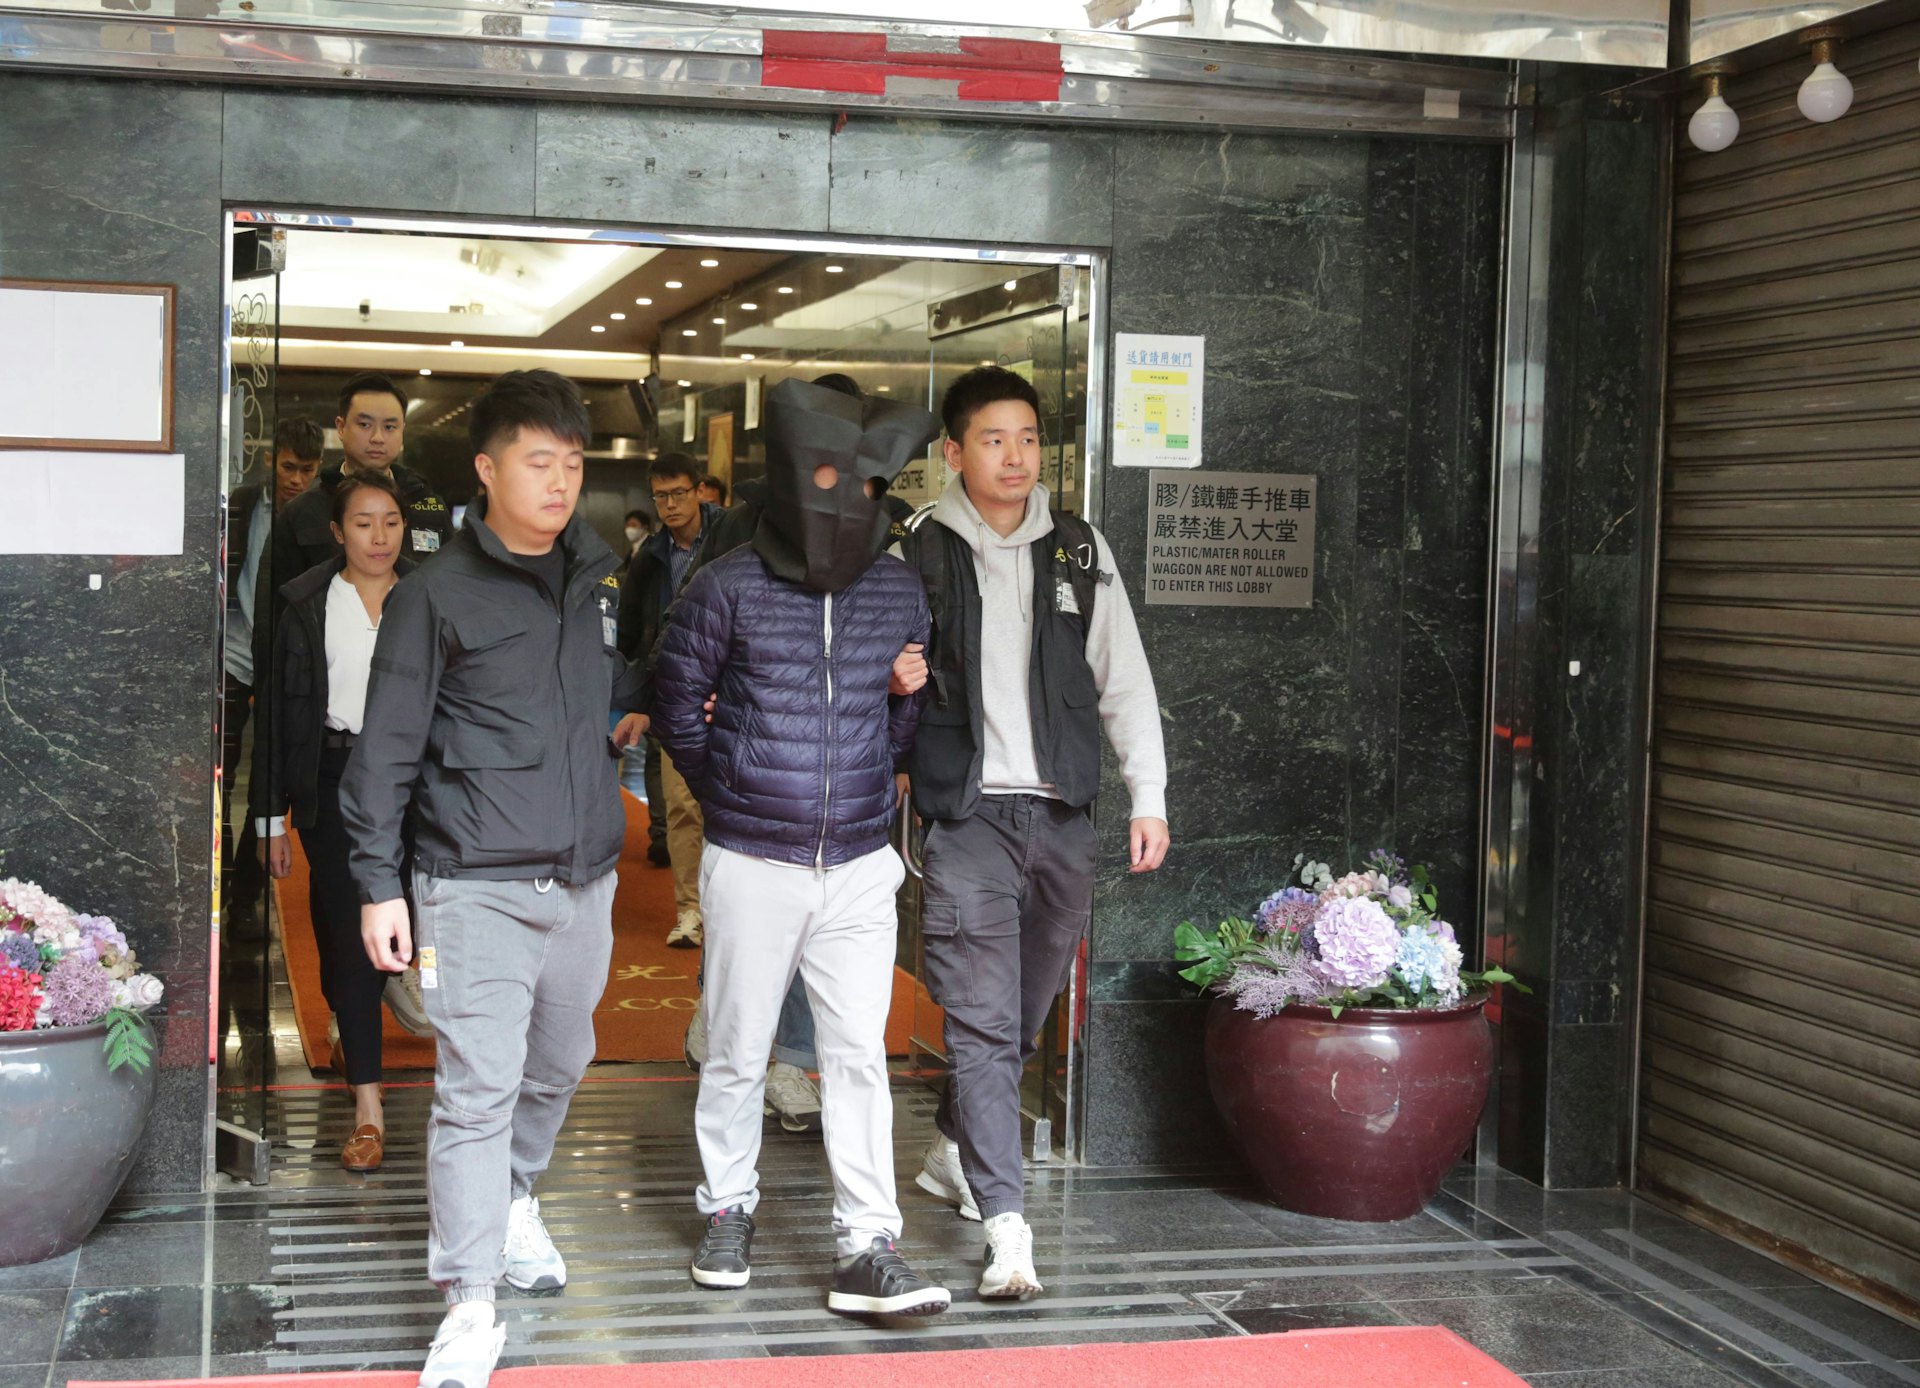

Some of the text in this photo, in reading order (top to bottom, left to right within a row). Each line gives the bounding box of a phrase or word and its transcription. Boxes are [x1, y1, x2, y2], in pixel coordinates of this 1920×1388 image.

[1155, 483, 1311, 512] 膠/鐵轆手推車
[1154, 514, 1298, 542] 嚴禁進入大堂
[1153, 546, 1286, 561] PLASTIC/MATER ROLLER
[1152, 562, 1309, 578] WAGGON ARE NOT ALLOWED
[1151, 579, 1273, 595] TO ENTER THIS LOBBY
